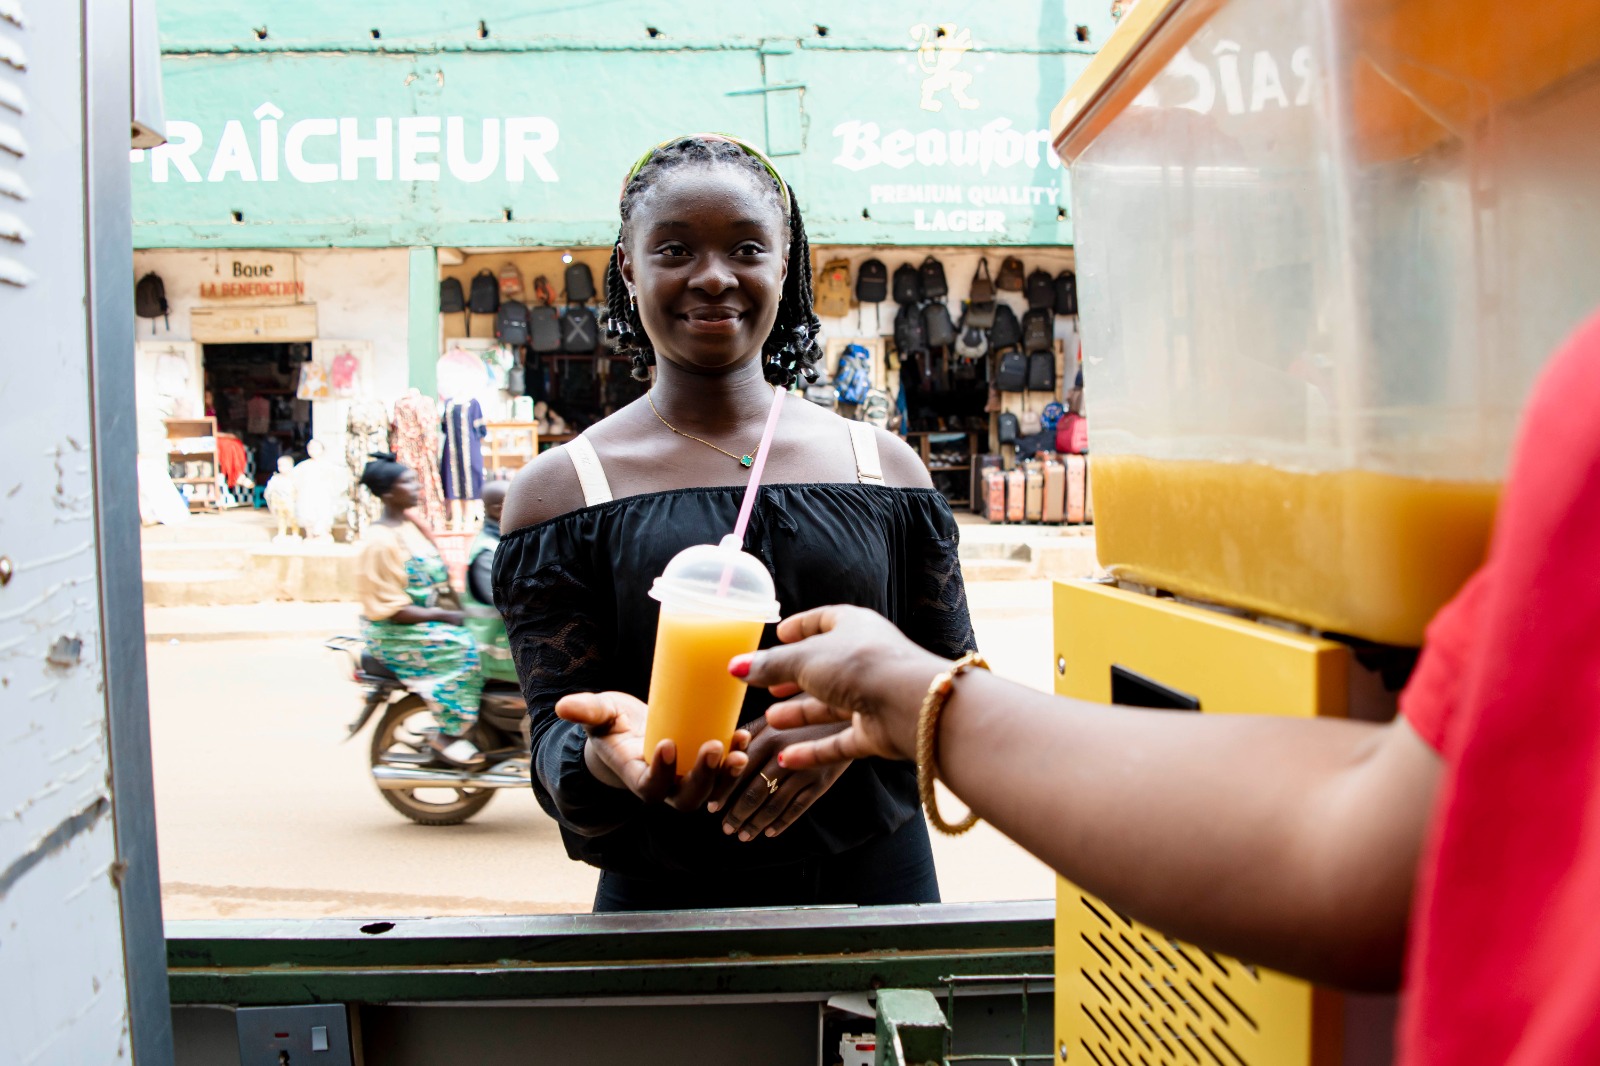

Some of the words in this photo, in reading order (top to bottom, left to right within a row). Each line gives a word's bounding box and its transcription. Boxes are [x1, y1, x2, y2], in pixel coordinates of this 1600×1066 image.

[130, 101, 559, 183] RAÎCHEUR
[870, 184, 962, 204] PREMIUM
[967, 184, 1060, 207] QUALITY
[914, 209, 1006, 233] LAGER
[200, 282, 217, 297] LA
[221, 280, 304, 297] BENEDICTION
